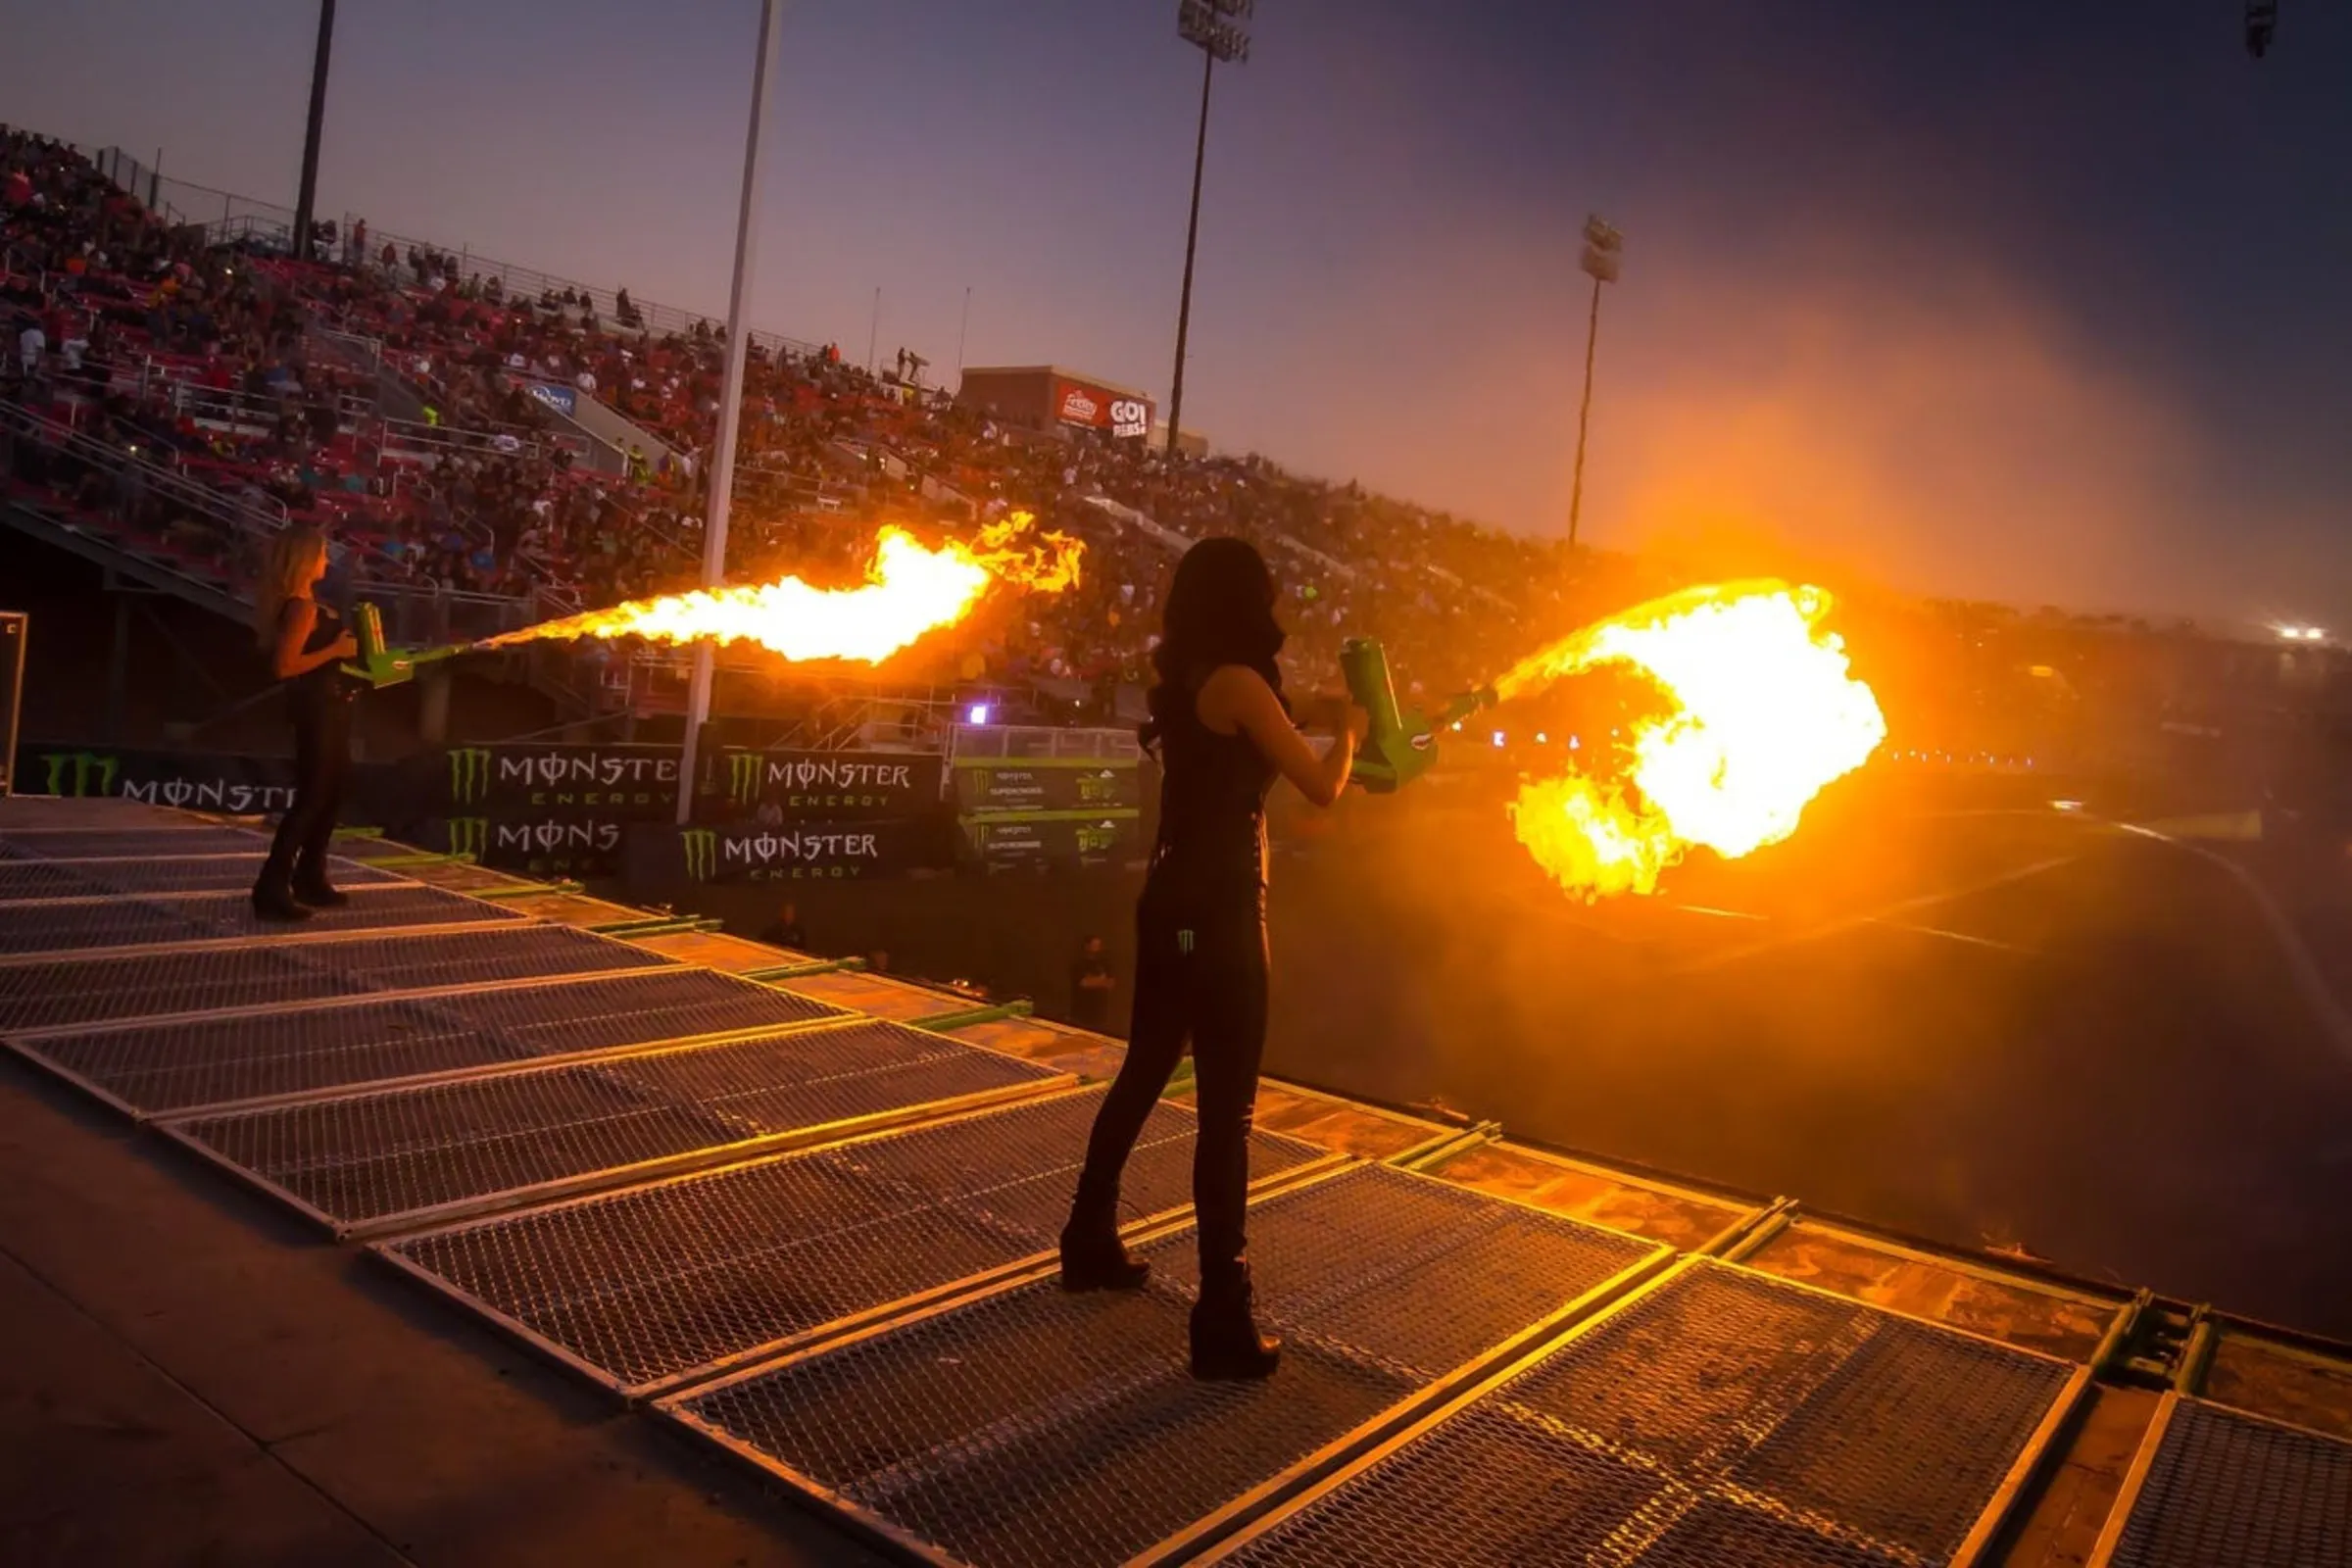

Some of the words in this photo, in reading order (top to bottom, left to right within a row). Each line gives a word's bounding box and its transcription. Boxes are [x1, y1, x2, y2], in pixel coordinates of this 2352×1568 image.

[767, 758, 911, 790] MONSTER
[788, 795, 890, 808] ENERGY
[723, 830, 879, 863] MONSTER
[749, 865, 862, 882] ENERGY
